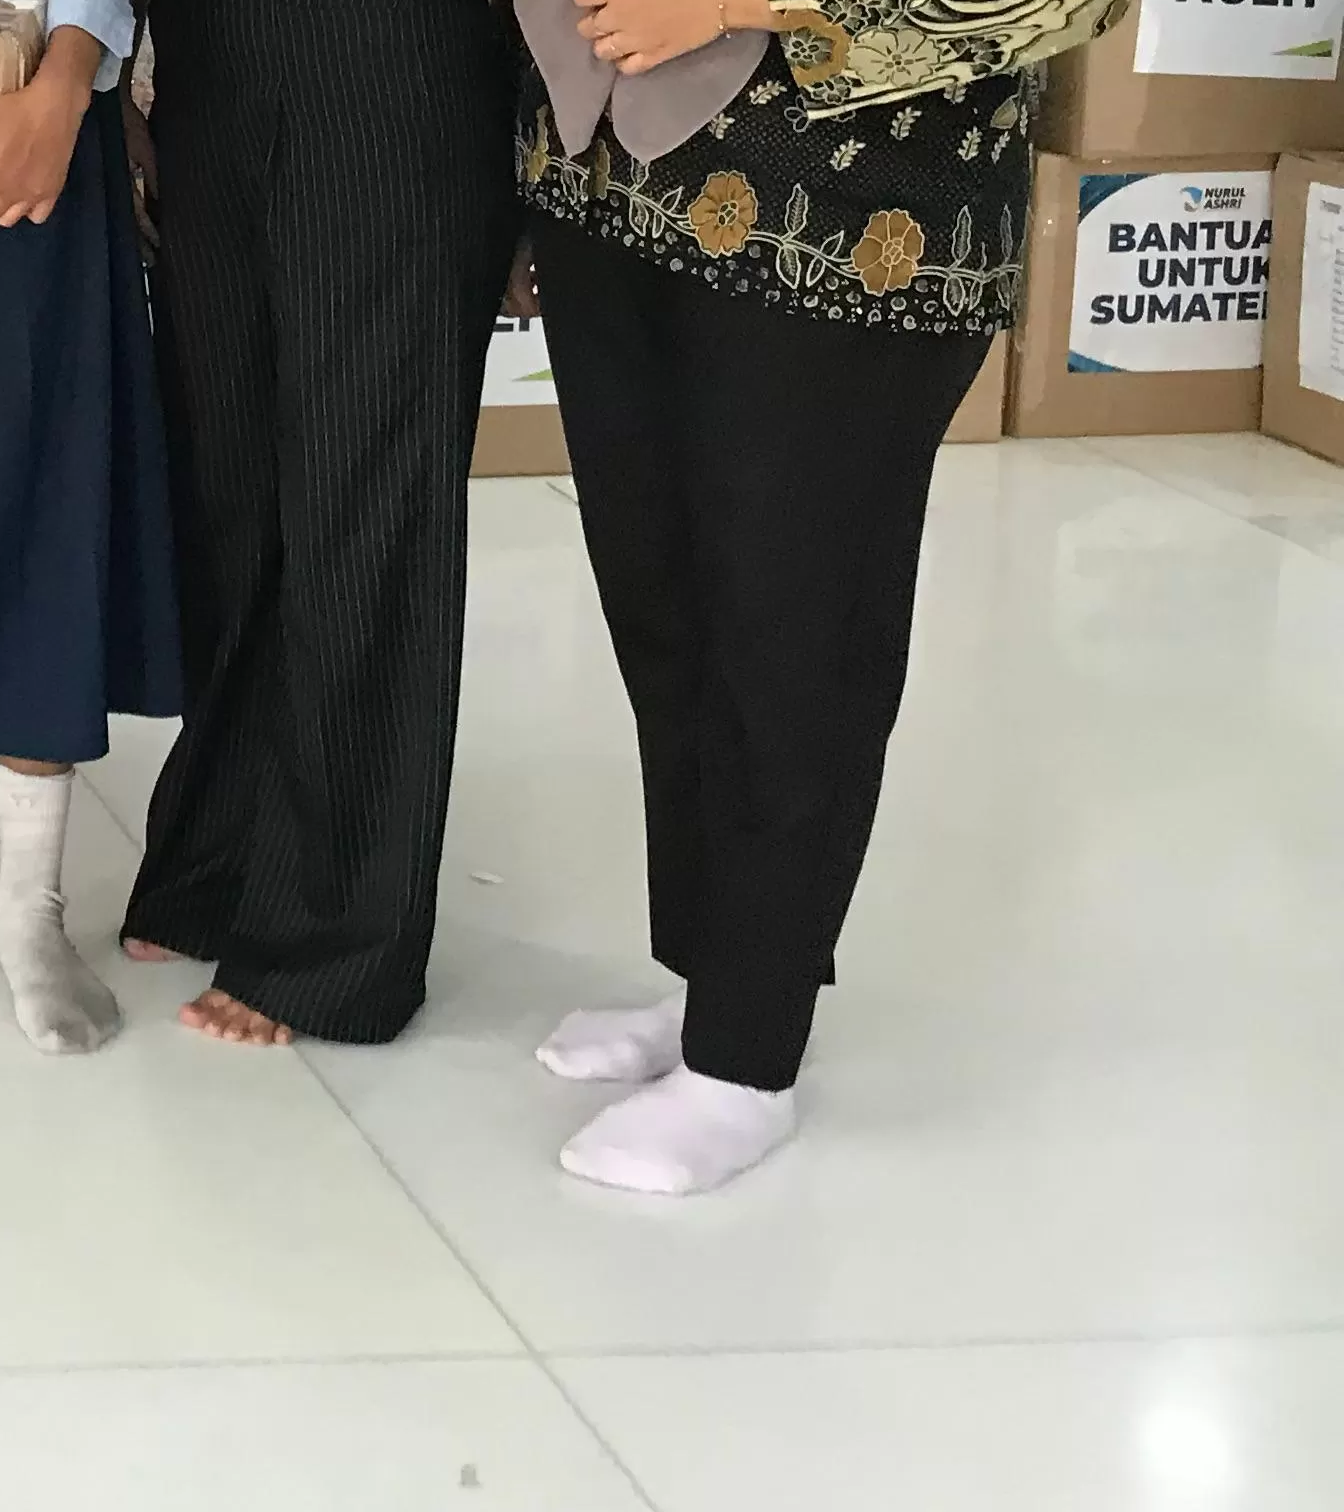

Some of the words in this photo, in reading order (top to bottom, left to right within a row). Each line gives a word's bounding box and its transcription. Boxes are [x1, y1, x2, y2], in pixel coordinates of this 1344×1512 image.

[1204, 198, 1242, 210] ASHRI
[1205, 187, 1246, 198] NURUL
[1108, 219, 1272, 253] BANTUA
[1138, 256, 1269, 288] UNTUK
[1090, 290, 1267, 324] SUMATE
